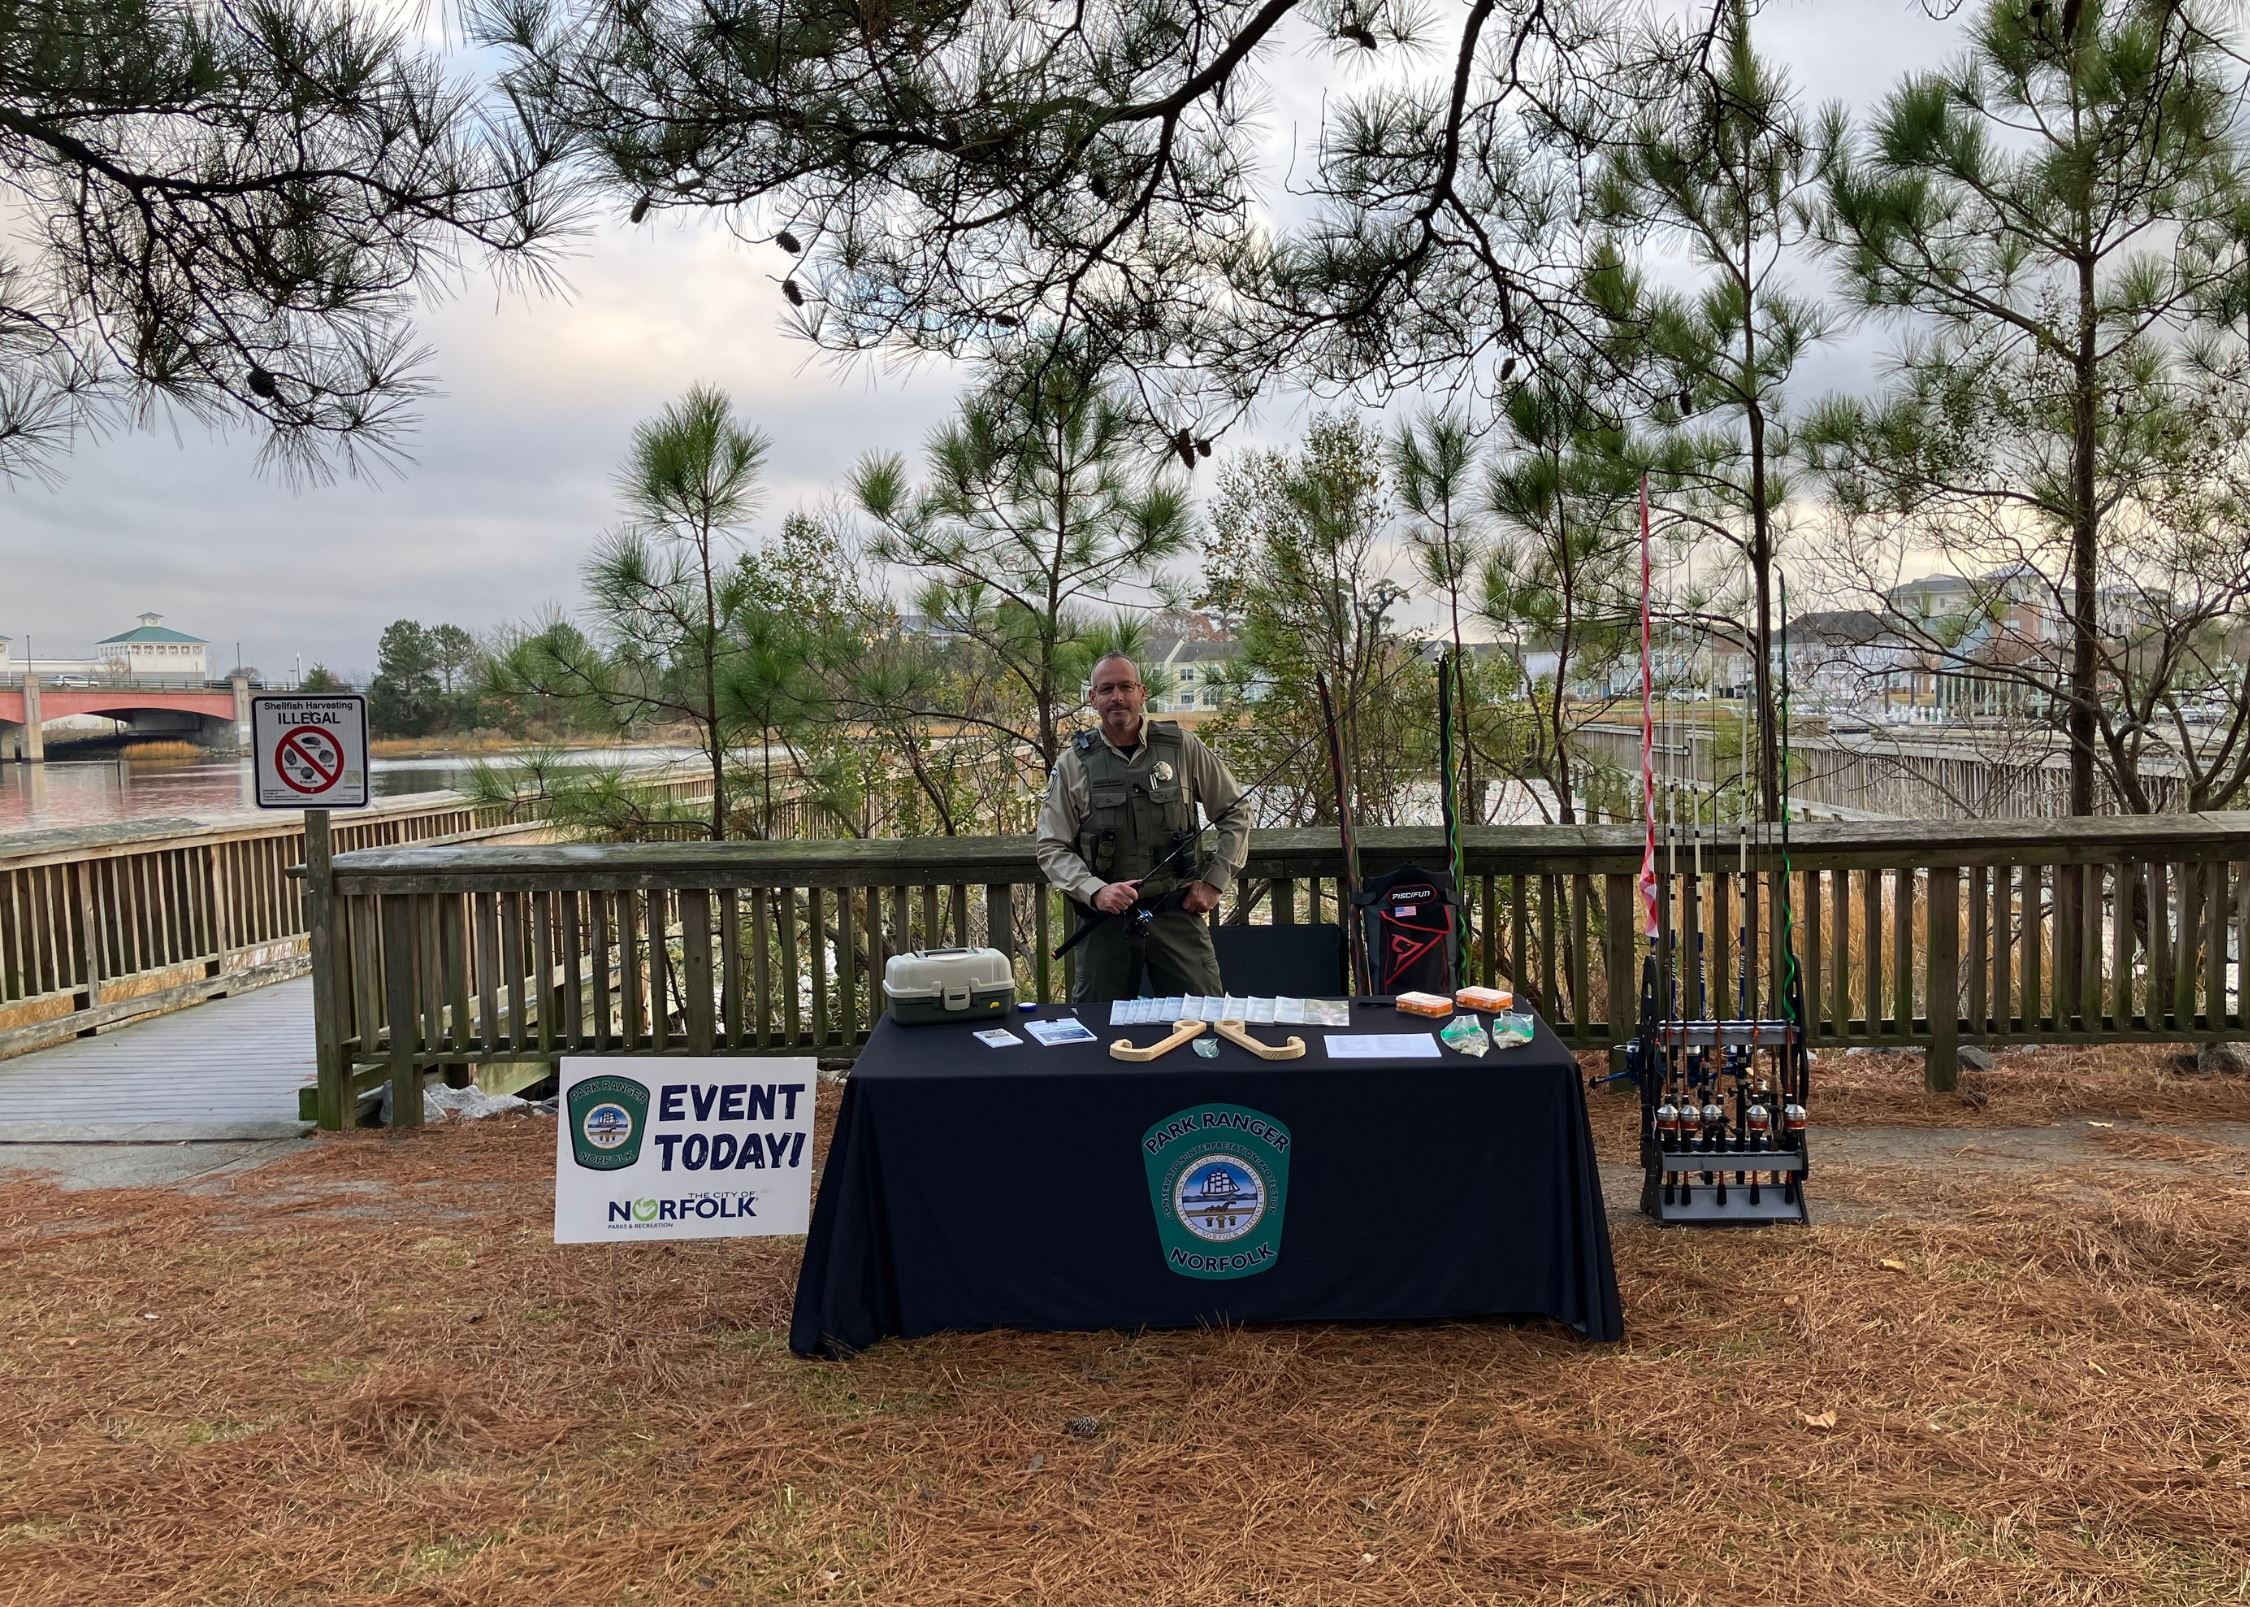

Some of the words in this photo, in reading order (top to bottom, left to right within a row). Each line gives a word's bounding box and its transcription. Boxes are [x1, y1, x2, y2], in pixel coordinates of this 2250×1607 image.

[264, 701, 303, 711] Shellfish
[306, 701, 353, 711] Harvesting
[278, 712, 341, 725] ILLEGAL
[1391, 890, 1431, 900] PISCIFUN
[570, 1081, 600, 1102] PARK
[602, 1080, 647, 1105] RANGER
[659, 1083, 806, 1122] EVENT
[1144, 1115, 1200, 1155] PARK
[1202, 1112, 1290, 1153] RANGER
[579, 1150, 635, 1164] NORFOLK
[654, 1131, 807, 1172] TODAY!
[608, 1196, 758, 1222] NORFOLK
[1169, 1242, 1278, 1272] NORFOLK
